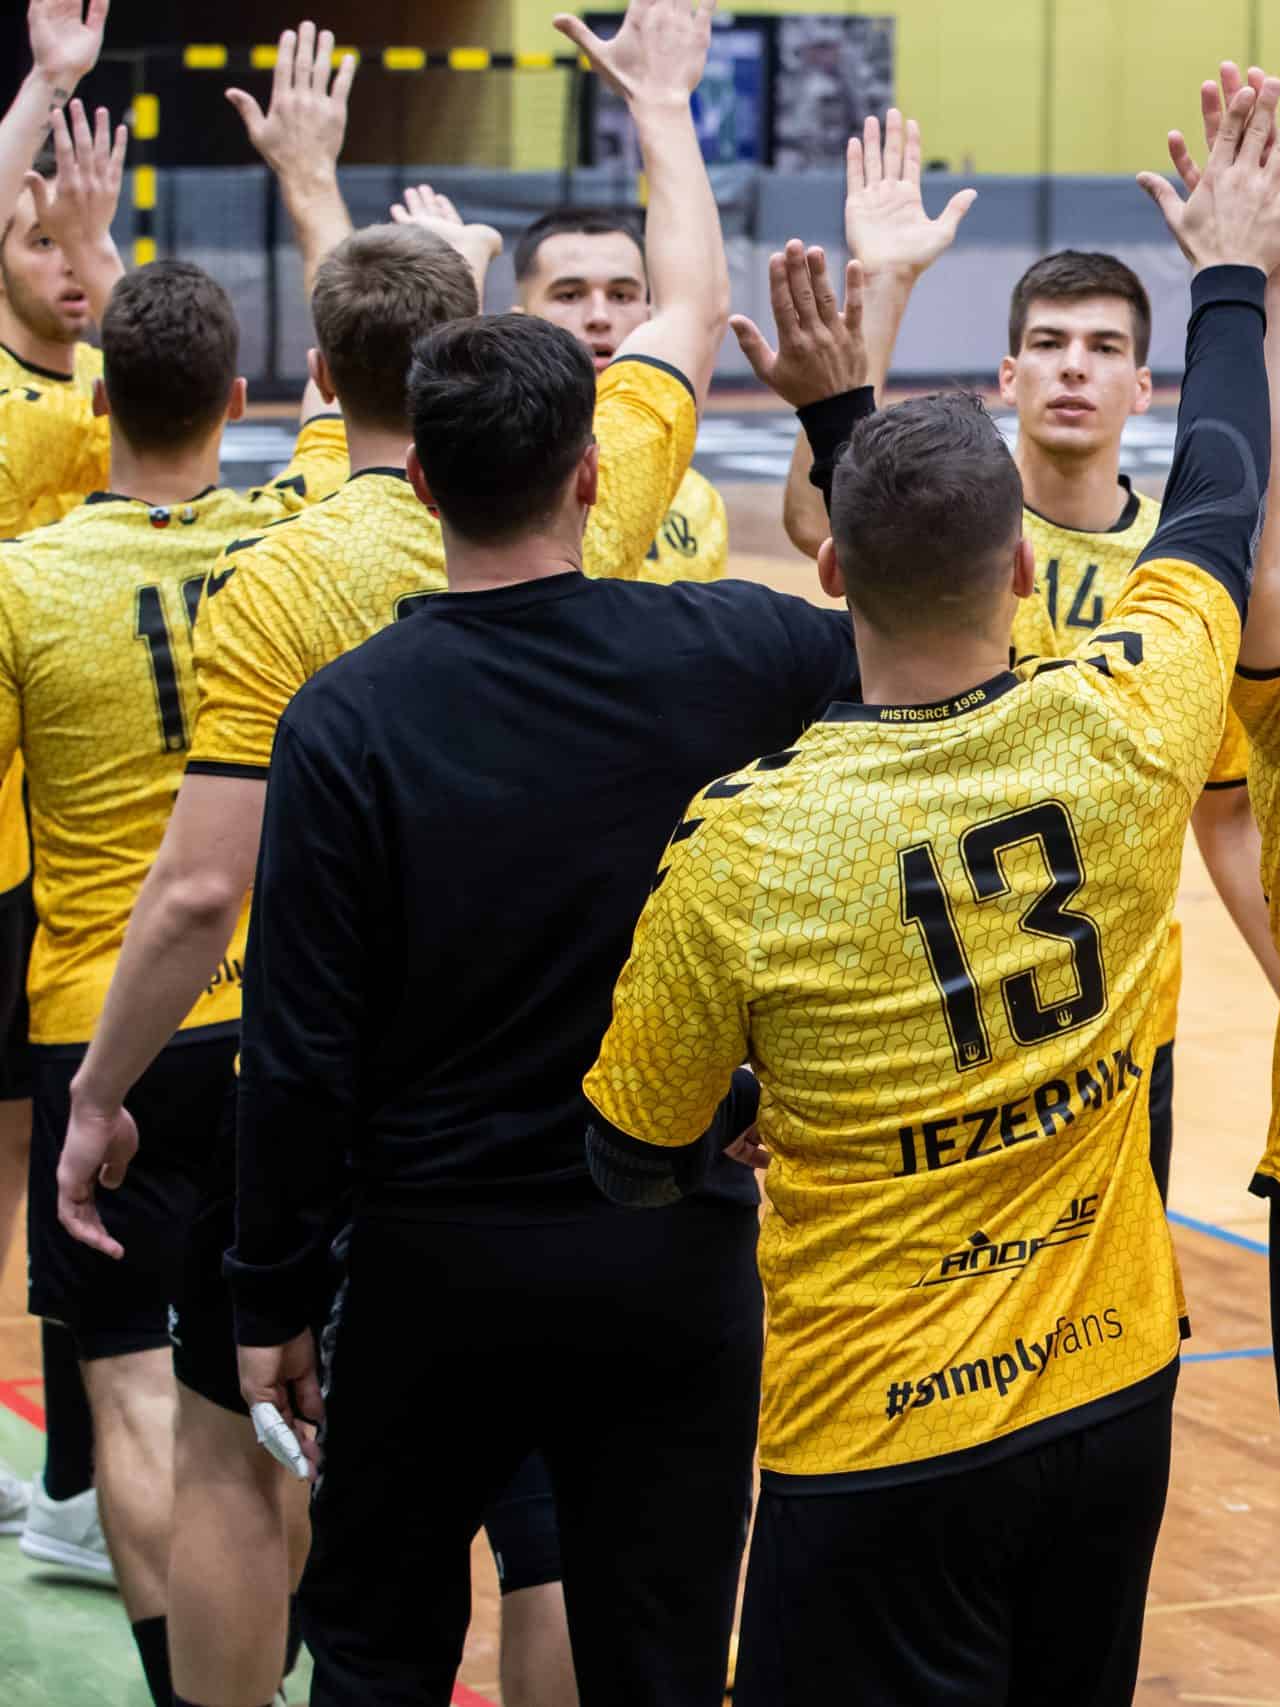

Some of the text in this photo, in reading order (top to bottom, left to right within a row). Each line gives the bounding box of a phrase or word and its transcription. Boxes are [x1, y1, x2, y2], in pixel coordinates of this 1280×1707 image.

[1044, 558, 1105, 631] 14
[131, 573, 208, 755] 1
[880, 689, 987, 721] #ISTOSRCE 1958
[897, 798, 1109, 1073] 13
